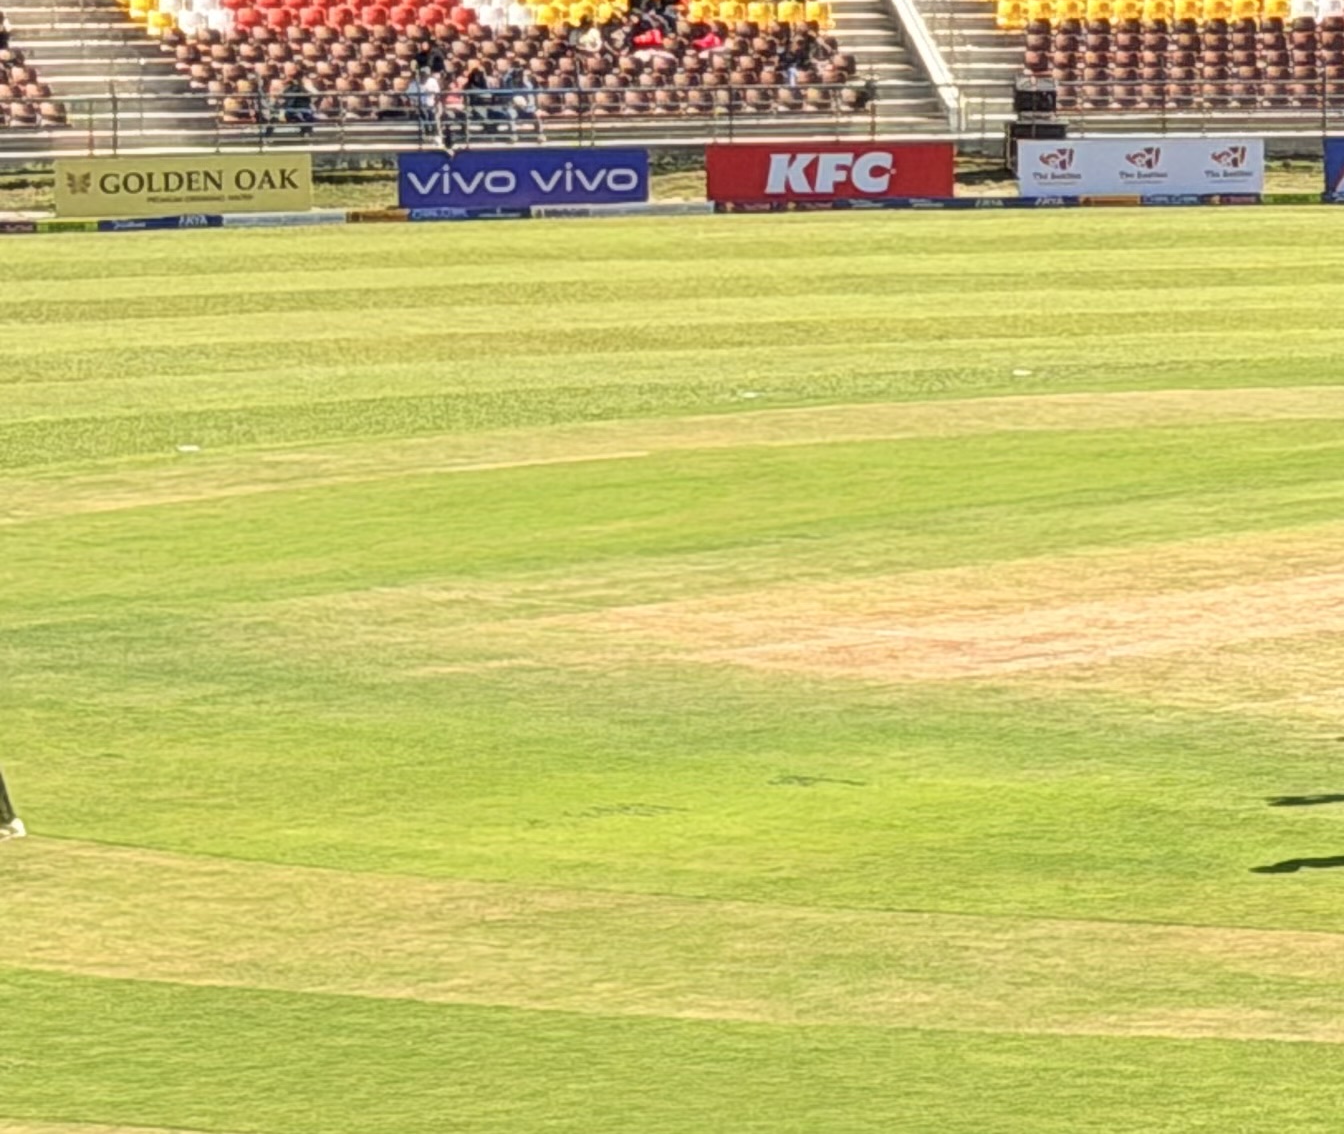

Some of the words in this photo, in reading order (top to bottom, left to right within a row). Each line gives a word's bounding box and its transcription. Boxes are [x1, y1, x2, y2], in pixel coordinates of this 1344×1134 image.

[99, 169, 223, 194] GOLDEN
[235, 168, 299, 192] OAK
[406, 163, 517, 195] vivo
[530, 161, 639, 192] vivo
[764, 152, 893, 195] KFC
